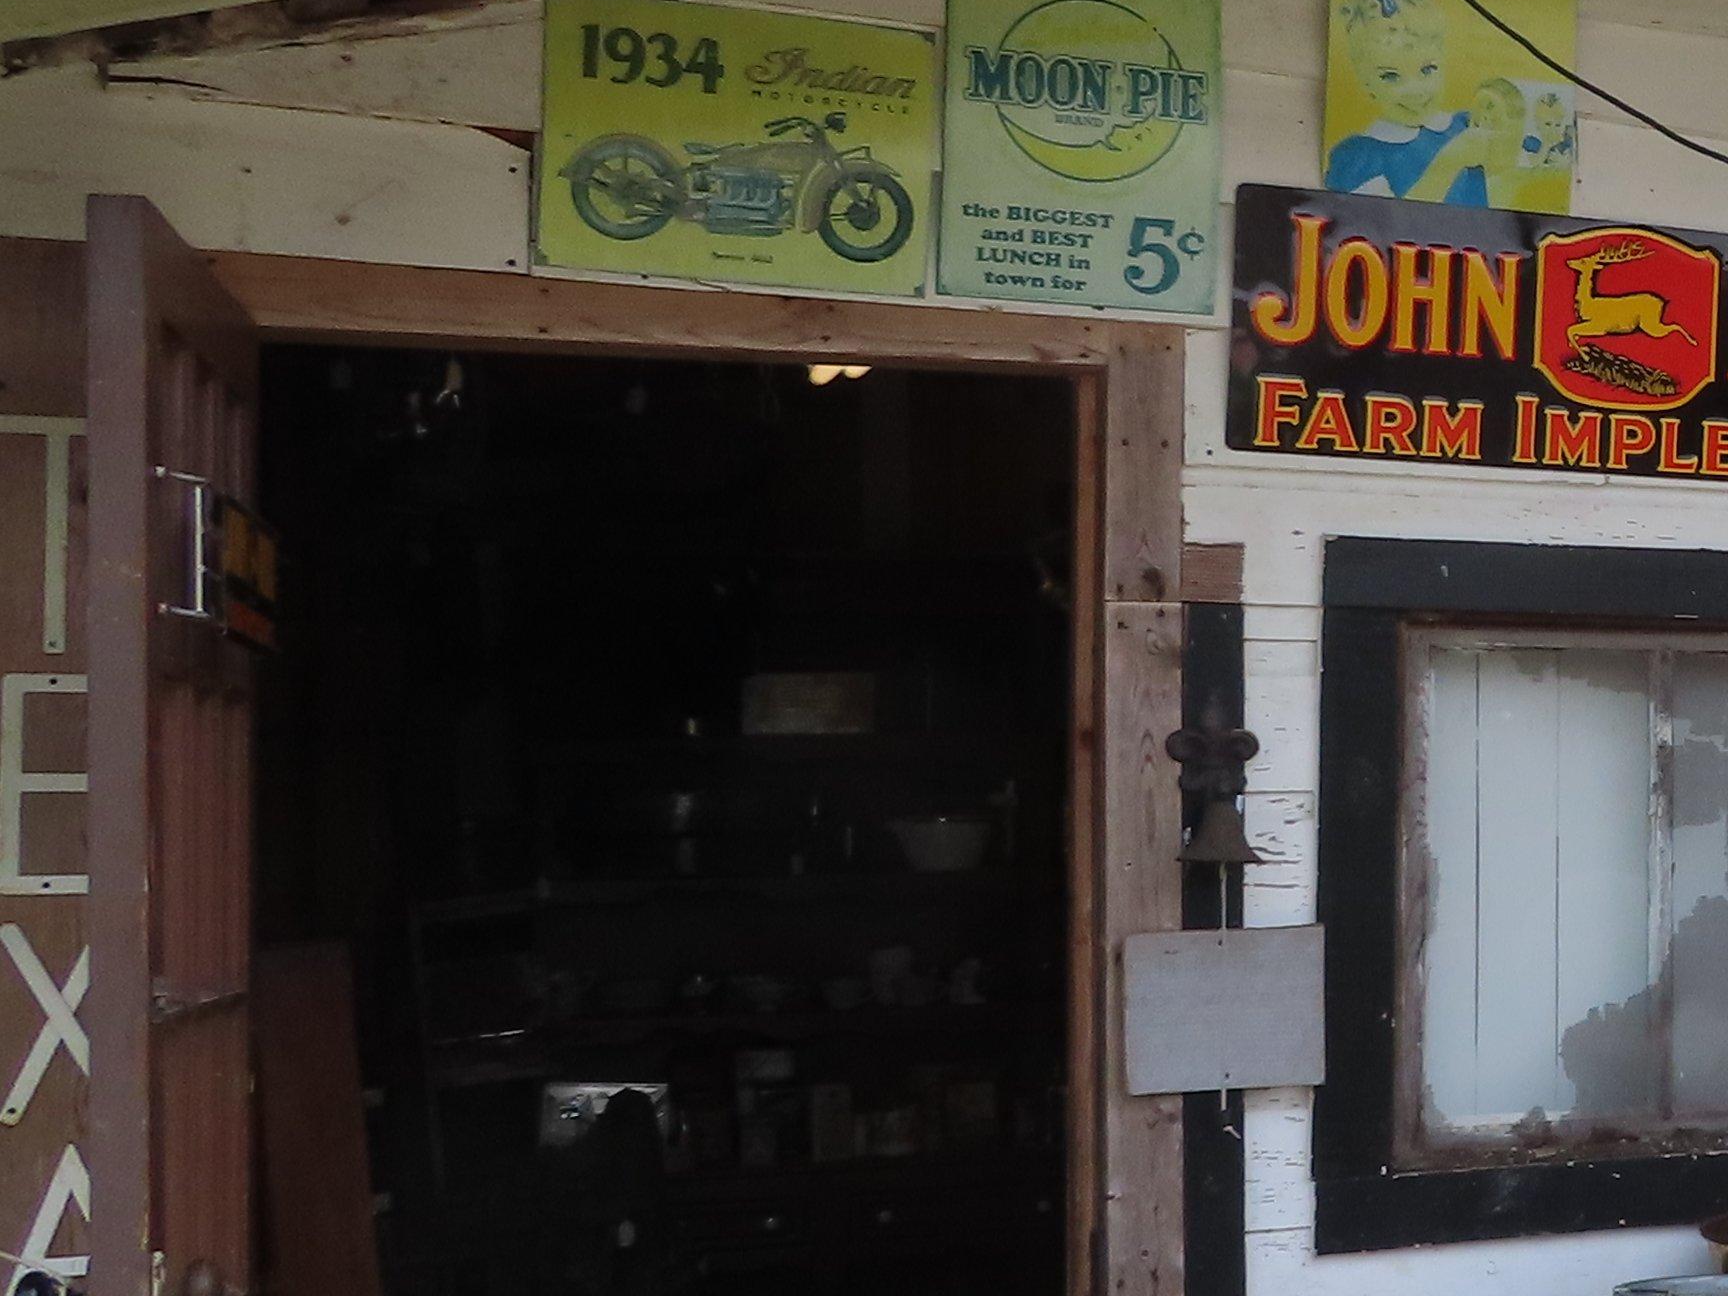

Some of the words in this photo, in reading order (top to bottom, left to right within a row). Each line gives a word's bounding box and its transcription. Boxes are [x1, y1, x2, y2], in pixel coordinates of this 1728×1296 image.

[580, 23, 725, 95] 1934
[745, 47, 917, 99] Indian
[964, 47, 1117, 115] MOON
[1122, 62, 1208, 125] PIE
[961, 203, 1001, 220] the
[1006, 205, 1116, 229] BIGGEST
[980, 228, 1025, 243] and
[1031, 229, 1094, 250] BEST
[975, 246, 1063, 268] LUNCH
[1067, 255, 1091, 271] in
[983, 270, 1046, 289] town
[1049, 274, 1088, 292] for
[1250, 211, 1521, 362] JOHN
[1252, 372, 1484, 461] FARM
